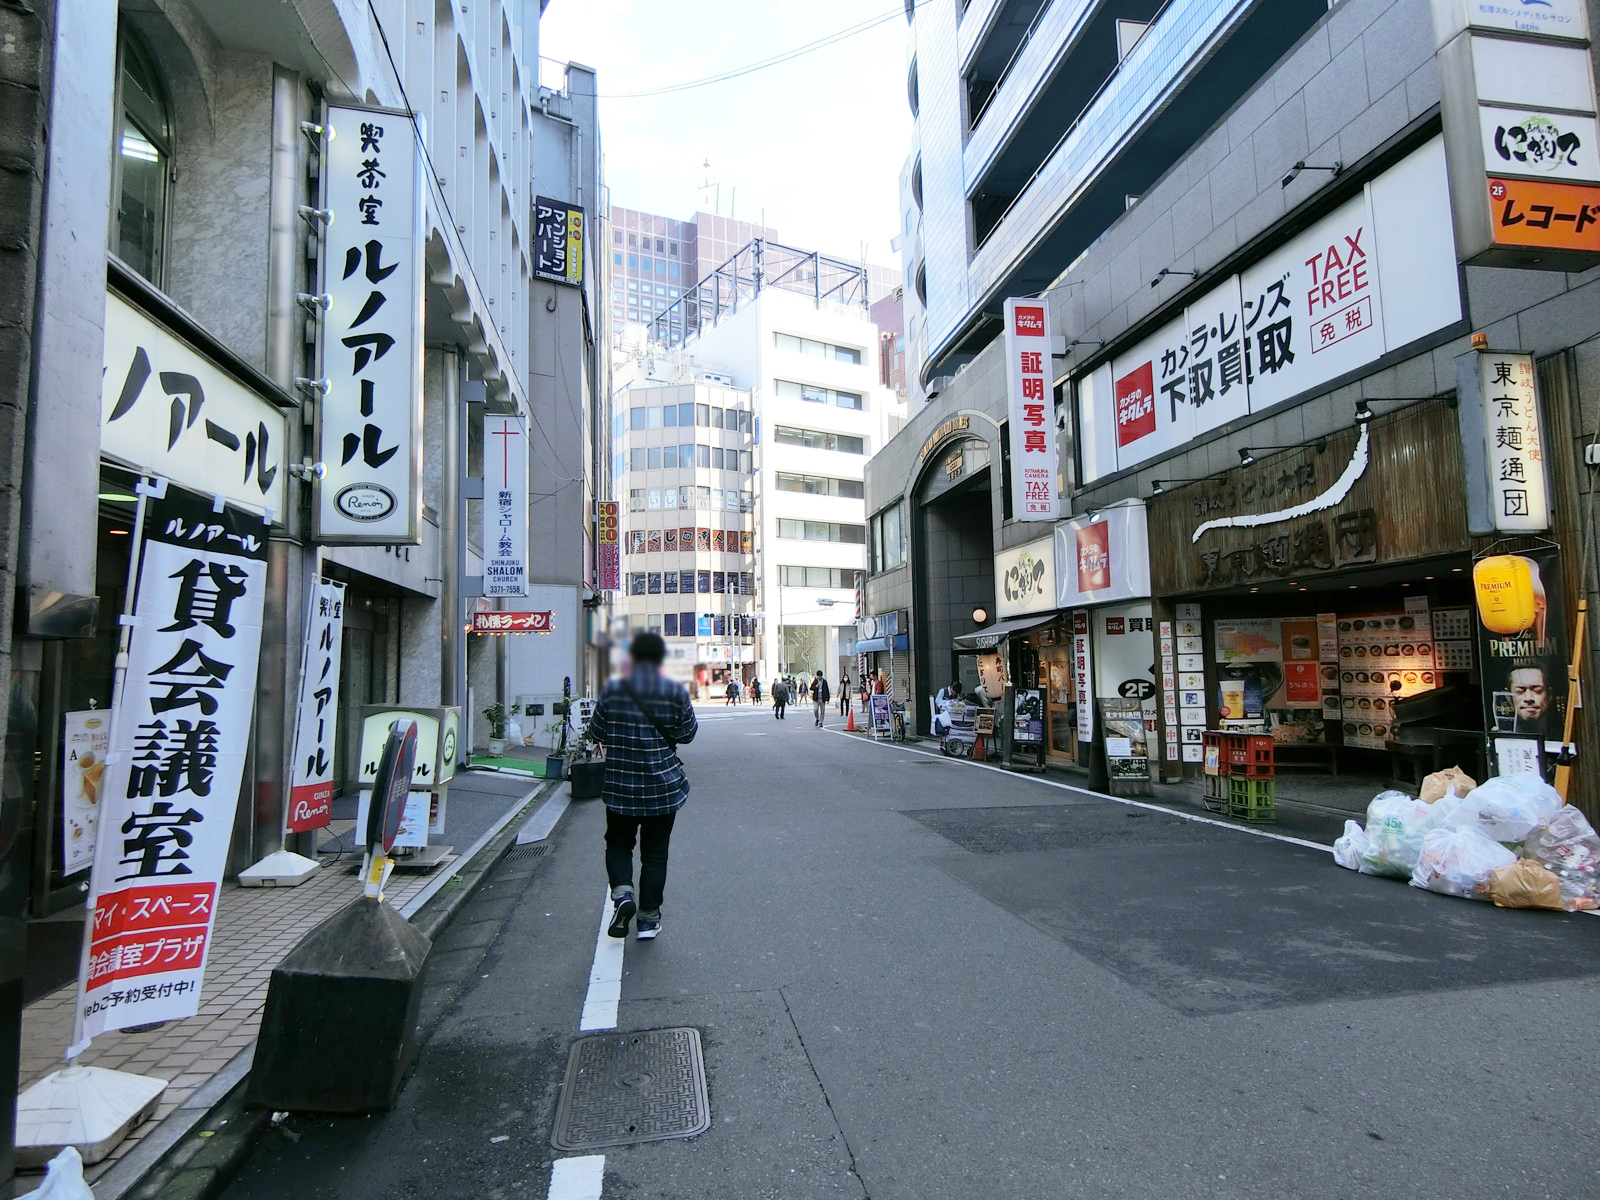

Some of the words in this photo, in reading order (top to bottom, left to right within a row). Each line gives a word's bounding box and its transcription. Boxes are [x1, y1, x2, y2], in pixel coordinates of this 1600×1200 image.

[1515, 20, 1540, 31] Lapis
[356, 122, 388, 227] 喫茶室
[1491, 186, 1504, 196] 2F
[1500, 199, 1600, 233] レコード
[538, 205, 552, 269] アパート
[553, 209, 566, 272] マンション
[1305, 226, 1366, 286] TAX
[1307, 259, 1369, 317] FREE
[1017, 320, 1043, 329] キタムラ
[1160, 272, 1291, 379] カメラ・レンズ
[1320, 305, 1363, 345] 免税
[341, 239, 400, 470] ルノアール
[1160, 315, 1296, 423] 下取買取
[1020, 351, 1047, 454] 証明写真
[1119, 388, 1142, 410] カメラの
[1119, 394, 1153, 426] キタムラ
[1519, 362, 1543, 462] 讃岐うどん大使
[103, 345, 279, 496] ノアール
[1490, 362, 1530, 517] 東京麺通団
[1026, 482, 1049, 492] TAX
[1026, 492, 1050, 501] FREE
[498, 490, 513, 557] 新宿シャローム教会
[1030, 504, 1048, 512] 免税
[165, 517, 262, 553] ルノアール
[487, 566, 524, 576] SHALOM
[1080, 552, 1108, 573] キタムラ
[490, 585, 521, 594] 3371-7558
[1480, 581, 1512, 590] PREMIUM
[476, 614, 547, 629] 札幌ラーメン
[1512, 629, 1533, 641] The
[1489, 638, 1559, 658] PREMIUM
[1076, 638, 1087, 705] 証明写真
[306, 621, 335, 780] ルノアール
[1125, 682, 1149, 698] 2F
[115, 558, 249, 884] 貸会議室
[69, 749, 78, 761] A
[294, 799, 329, 823] Renoir
[313, 792, 330, 801] GINZA
[93, 893, 210, 930] マイ・スペース
